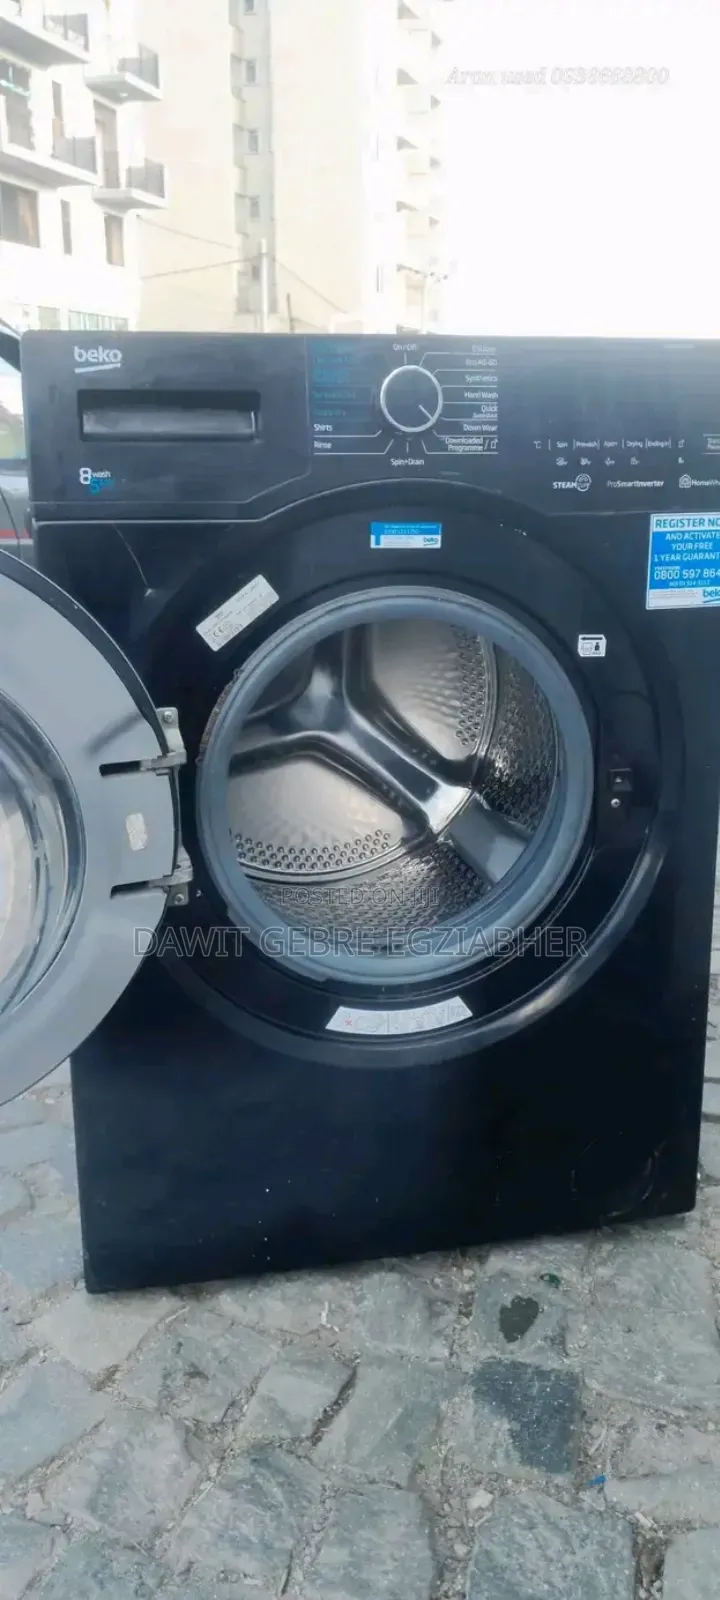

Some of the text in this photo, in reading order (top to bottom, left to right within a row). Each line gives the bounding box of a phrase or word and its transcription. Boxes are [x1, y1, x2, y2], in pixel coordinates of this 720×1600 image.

[74, 345, 122, 363] beko
[465, 374, 498, 383] Synthetics
[464, 391, 498, 399] Hand Wash
[482, 405, 498, 413] Quick
[314, 423, 332, 432] Shirts
[463, 424, 498, 432] Down Wear
[314, 441, 332, 449] Rinse
[448, 444, 482, 452] Programme
[80, 468, 92, 484] 8
[552, 481, 576, 489] STEAM
[606, 480, 664, 488] ProSmartInverter
[655, 518, 706, 528] REGISTER
[666, 533, 682, 541] AND
[672, 542, 713, 551] YOUR FREE
[660, 554, 682, 562] YEAR
[654, 570, 680, 580] 0800
[682, 569, 700, 579] 597
